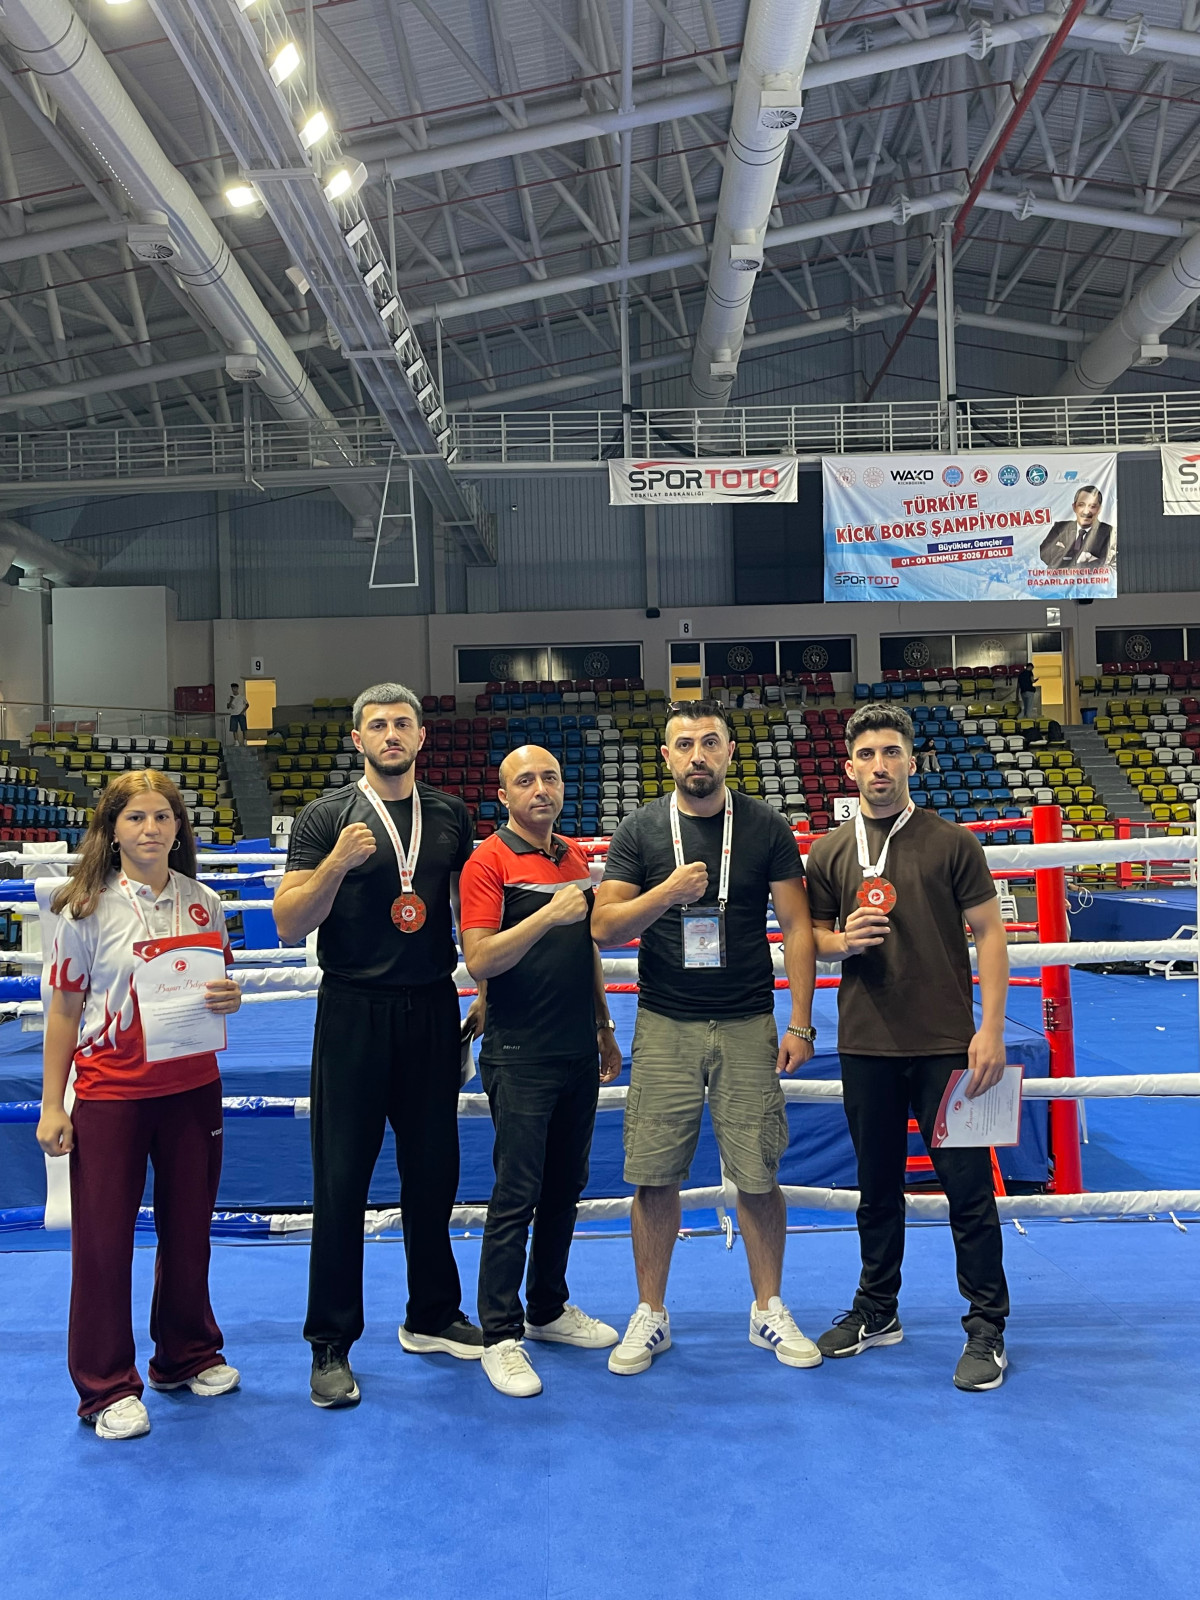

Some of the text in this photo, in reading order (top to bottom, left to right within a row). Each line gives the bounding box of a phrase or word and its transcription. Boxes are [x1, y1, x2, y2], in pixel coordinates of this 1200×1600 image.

[890, 469, 934, 481] WAKO
[902, 492, 979, 516] TÜRKİYE
[880, 521, 927, 541] BOKS
[931, 507, 1052, 538] ŞAMPİYONASI
[938, 538, 1003, 552] Büyükler, Gençler
[901, 558, 910, 566] 01
[916, 557, 926, 565] 09
[927, 554, 959, 563] TEMMUZ
[962, 552, 981, 560] 2026
[987, 549, 1008, 558] BOLU
[1051, 611, 1057, 622] 7
[683, 622, 690, 634] 8
[255, 660, 262, 671] 9
[841, 804, 851, 819] 3
[276, 821, 284, 834] 4
